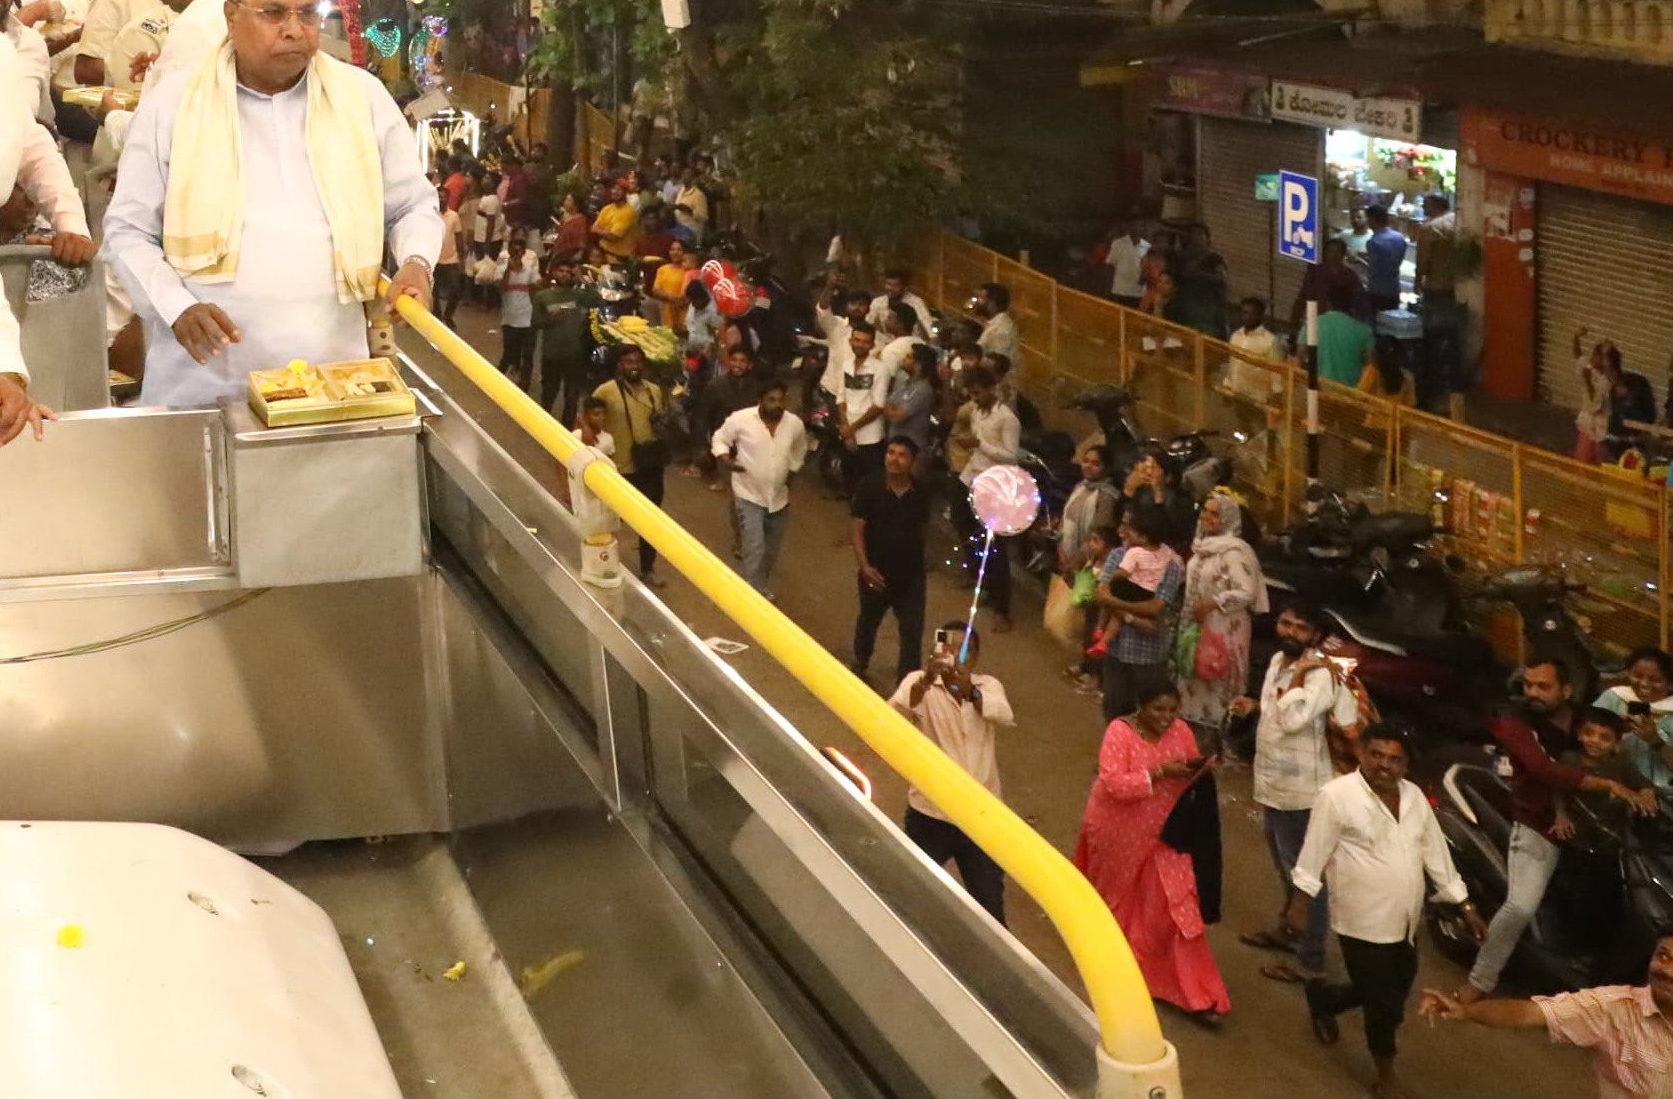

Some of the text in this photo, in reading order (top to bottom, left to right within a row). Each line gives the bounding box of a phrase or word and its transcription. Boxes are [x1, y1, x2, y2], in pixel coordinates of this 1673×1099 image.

[1500, 121, 1648, 163] CROCKERY
[1549, 154, 1595, 173] HOME
[1284, 181, 1309, 242] P
